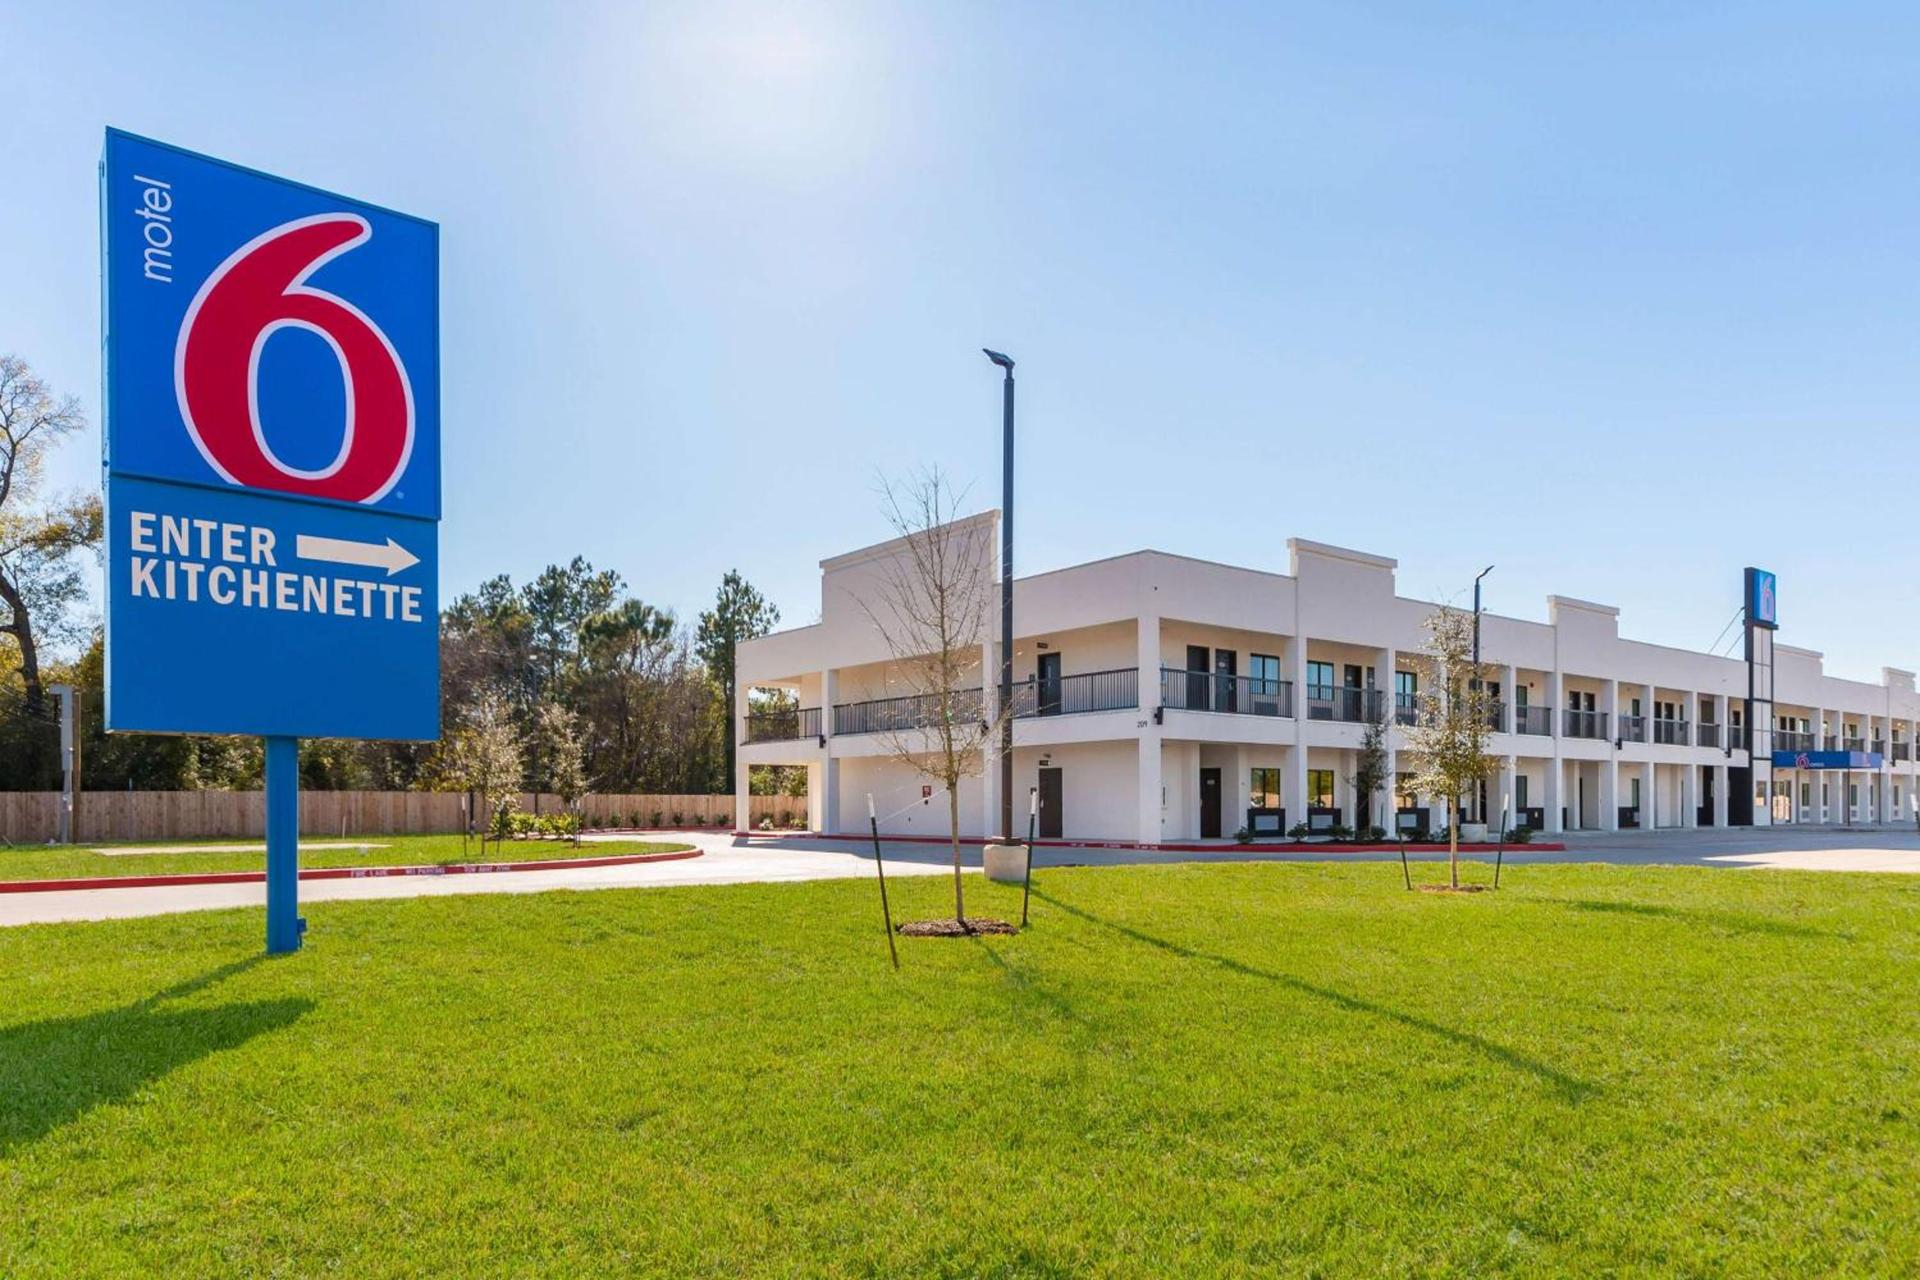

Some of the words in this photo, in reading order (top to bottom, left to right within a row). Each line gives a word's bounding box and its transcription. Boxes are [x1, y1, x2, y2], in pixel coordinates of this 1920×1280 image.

[134, 174, 172, 283] motel
[174, 212, 416, 505] 6
[131, 511, 277, 566] ENTER
[131, 556, 422, 623] KITCHENETTE
